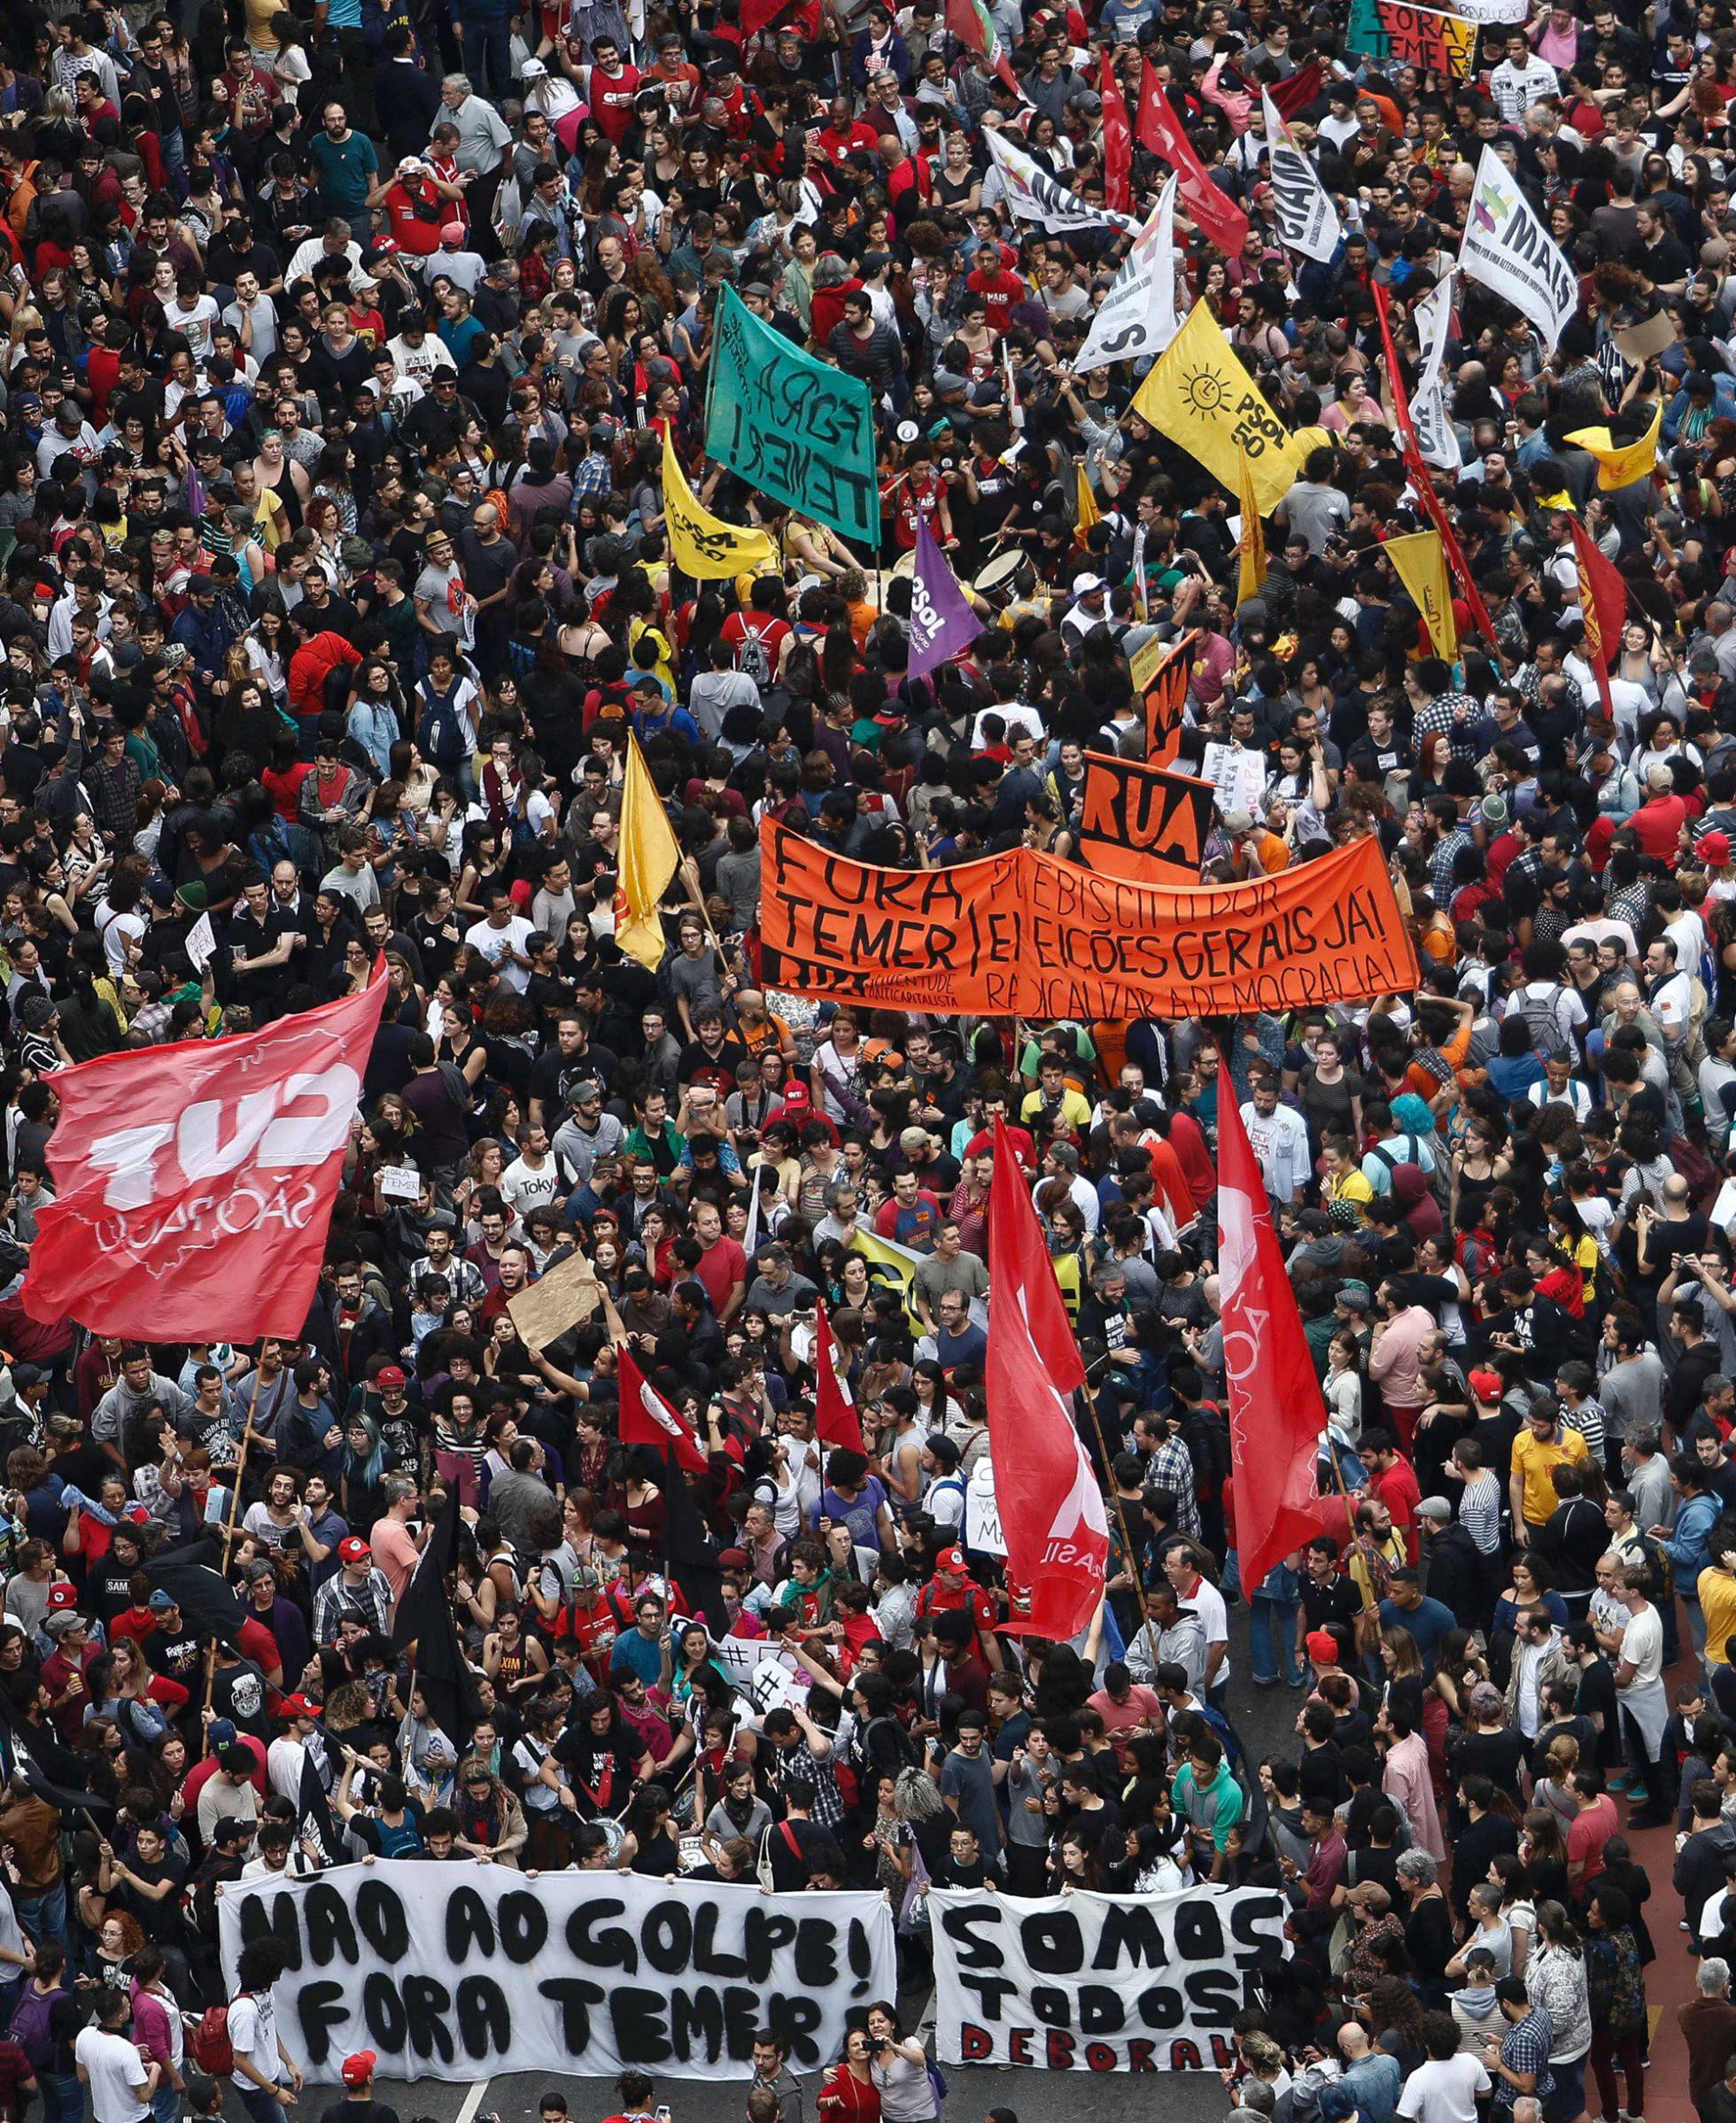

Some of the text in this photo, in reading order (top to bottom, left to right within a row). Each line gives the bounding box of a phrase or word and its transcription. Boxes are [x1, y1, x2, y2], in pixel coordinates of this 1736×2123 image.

[1362, 29, 1467, 76] TEMER
[1372, 3, 1459, 43] FORA
[1501, 204, 1571, 314] MAIS
[1230, 421, 1265, 458] 50
[1235, 392, 1284, 450] PSOL
[911, 576, 946, 640] PSOL
[1081, 764, 1199, 864] RUA
[775, 826, 963, 919] FORA
[1210, 879, 1280, 922] POR
[775, 889, 958, 971] TEMER
[1173, 905, 1317, 980] GERAIS
[1323, 885, 1387, 949] JÁ!
[778, 955, 864, 996] RUA
[446, 1885, 549, 1964] AO
[565, 1897, 872, 1999] GOLPE!
[942, 1895, 1284, 1974] SOMOS
[298, 1972, 511, 2065] FORA
[958, 1968, 1240, 2034] TODOS
[960, 2021, 1239, 2073] DEBORAH
